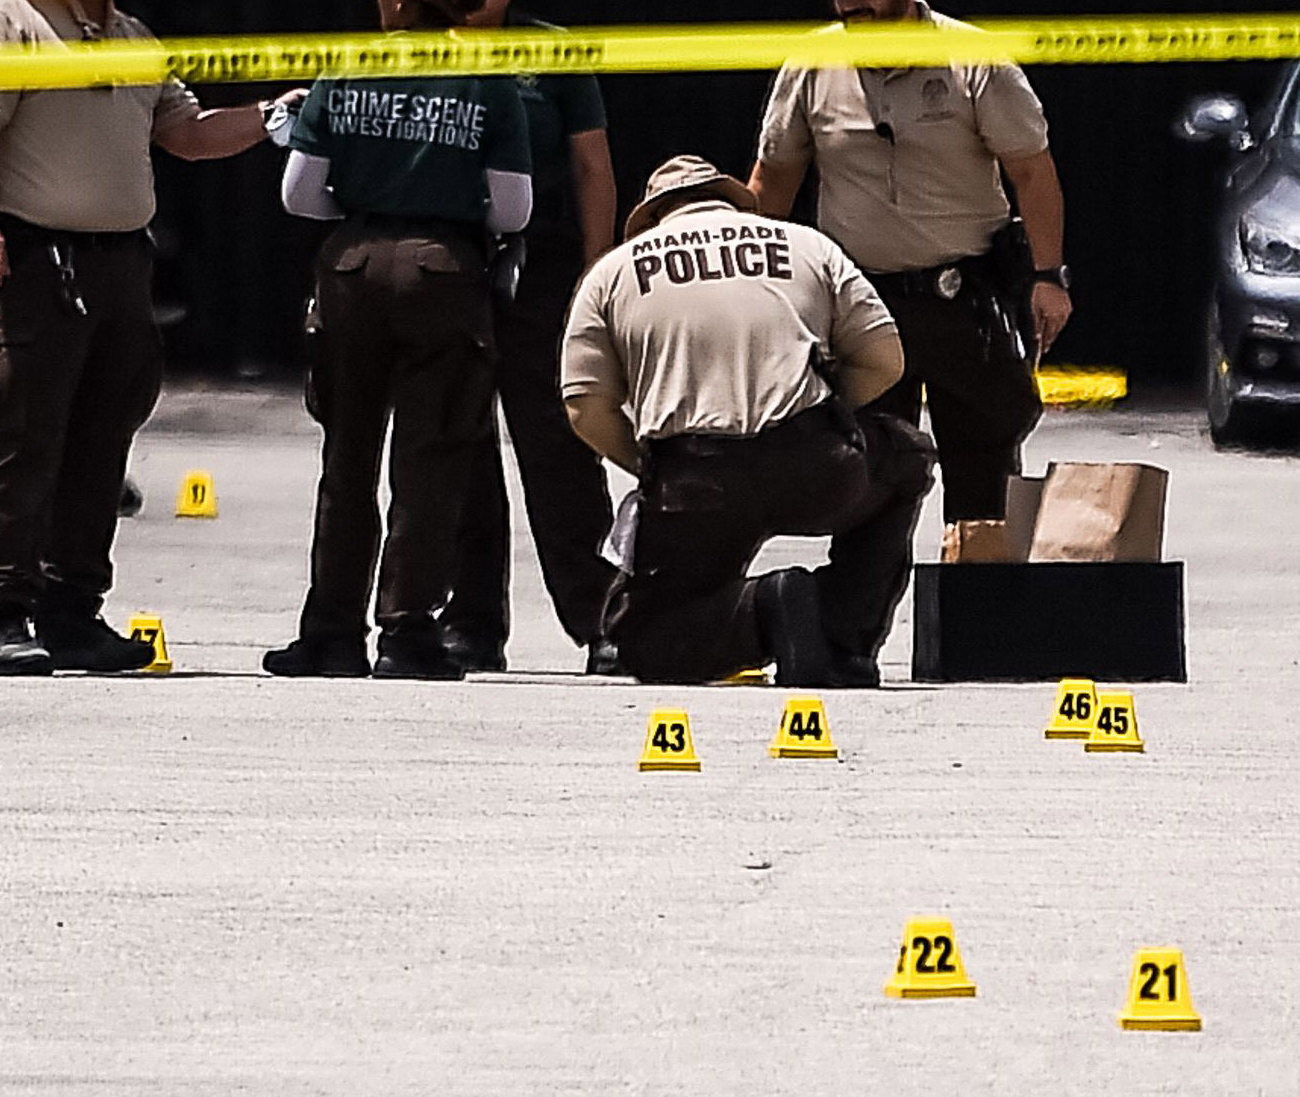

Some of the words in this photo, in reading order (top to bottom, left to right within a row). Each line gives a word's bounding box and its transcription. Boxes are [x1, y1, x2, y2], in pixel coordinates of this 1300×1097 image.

[328, 89, 408, 120] CRIME
[410, 94, 488, 133] SCENE
[328, 113, 483, 151] INVESTIGATIONS
[632, 225, 789, 257] MIAMI-DADE
[633, 241, 793, 296] POLICE
[1058, 692, 1092, 721] 46
[1097, 706, 1129, 735] 45
[652, 723, 686, 753] 43
[788, 711, 824, 741] 44
[911, 935, 956, 974] 22
[1138, 962, 1178, 1003] 21
